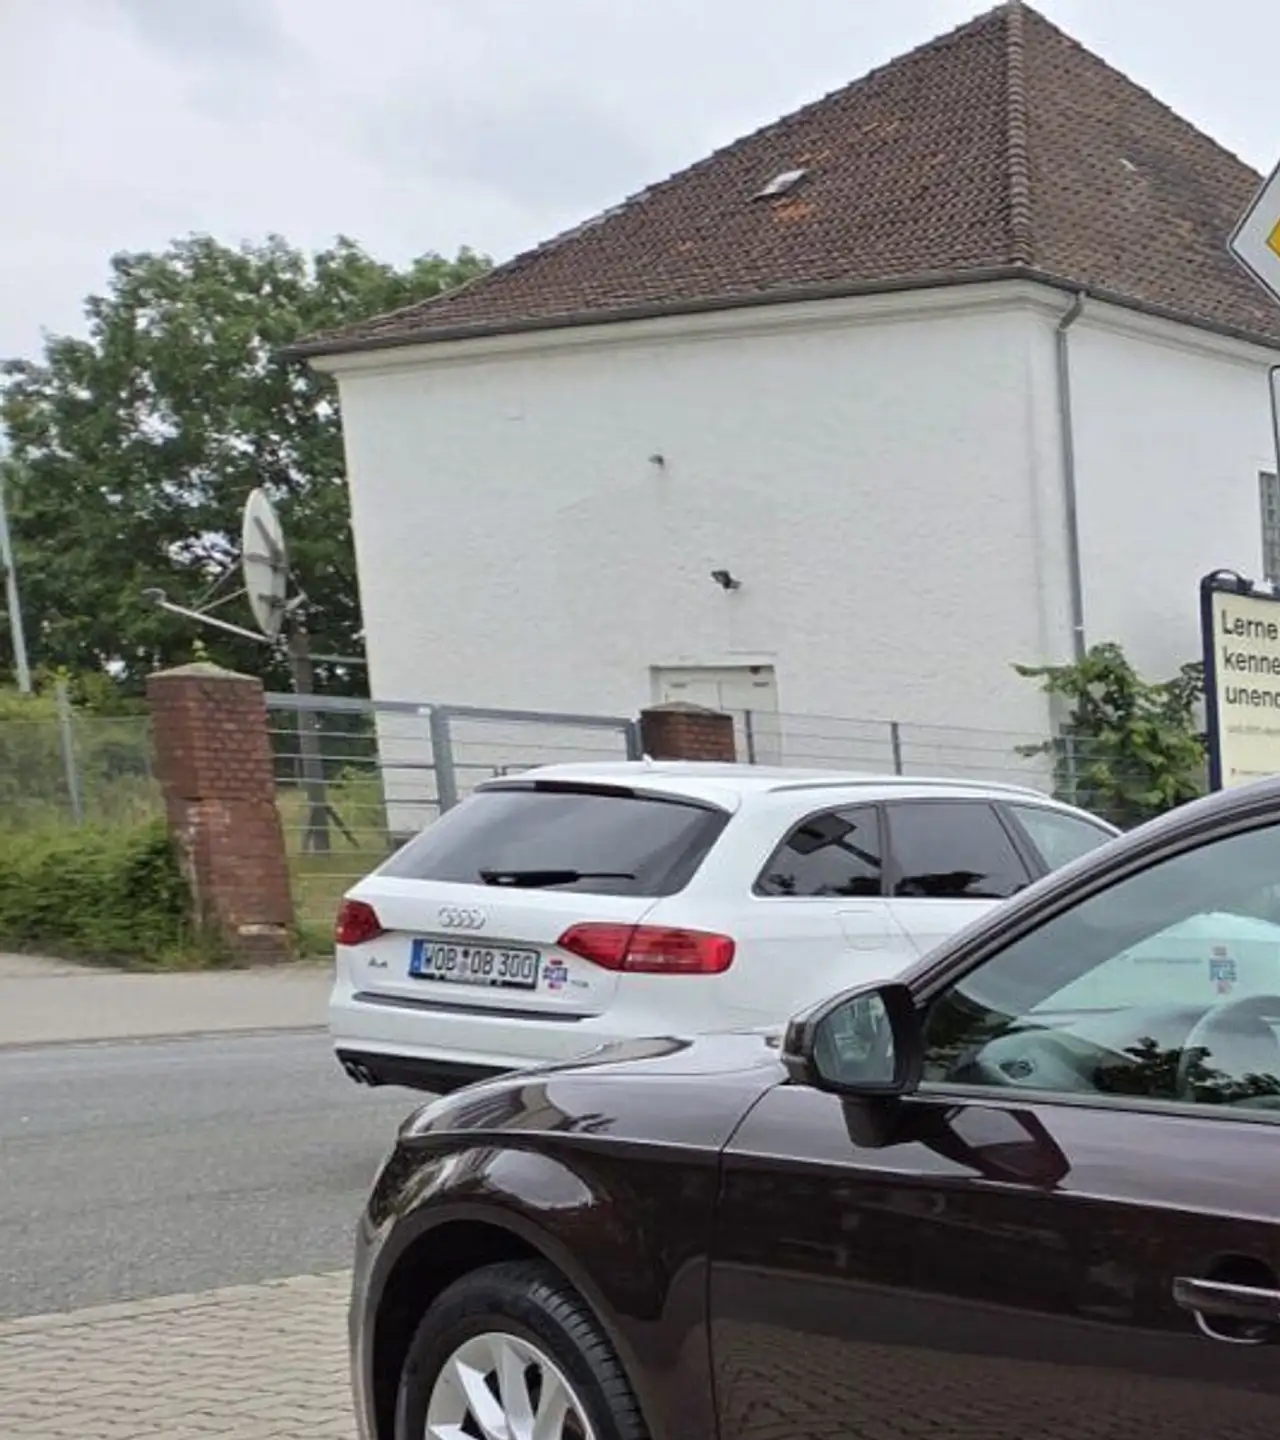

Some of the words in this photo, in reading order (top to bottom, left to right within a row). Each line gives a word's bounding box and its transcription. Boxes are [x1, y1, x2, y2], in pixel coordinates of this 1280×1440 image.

[1221, 609, 1278, 641] Lerne
[423, 945, 457, 971] WOB
[498, 953, 532, 979] 300
